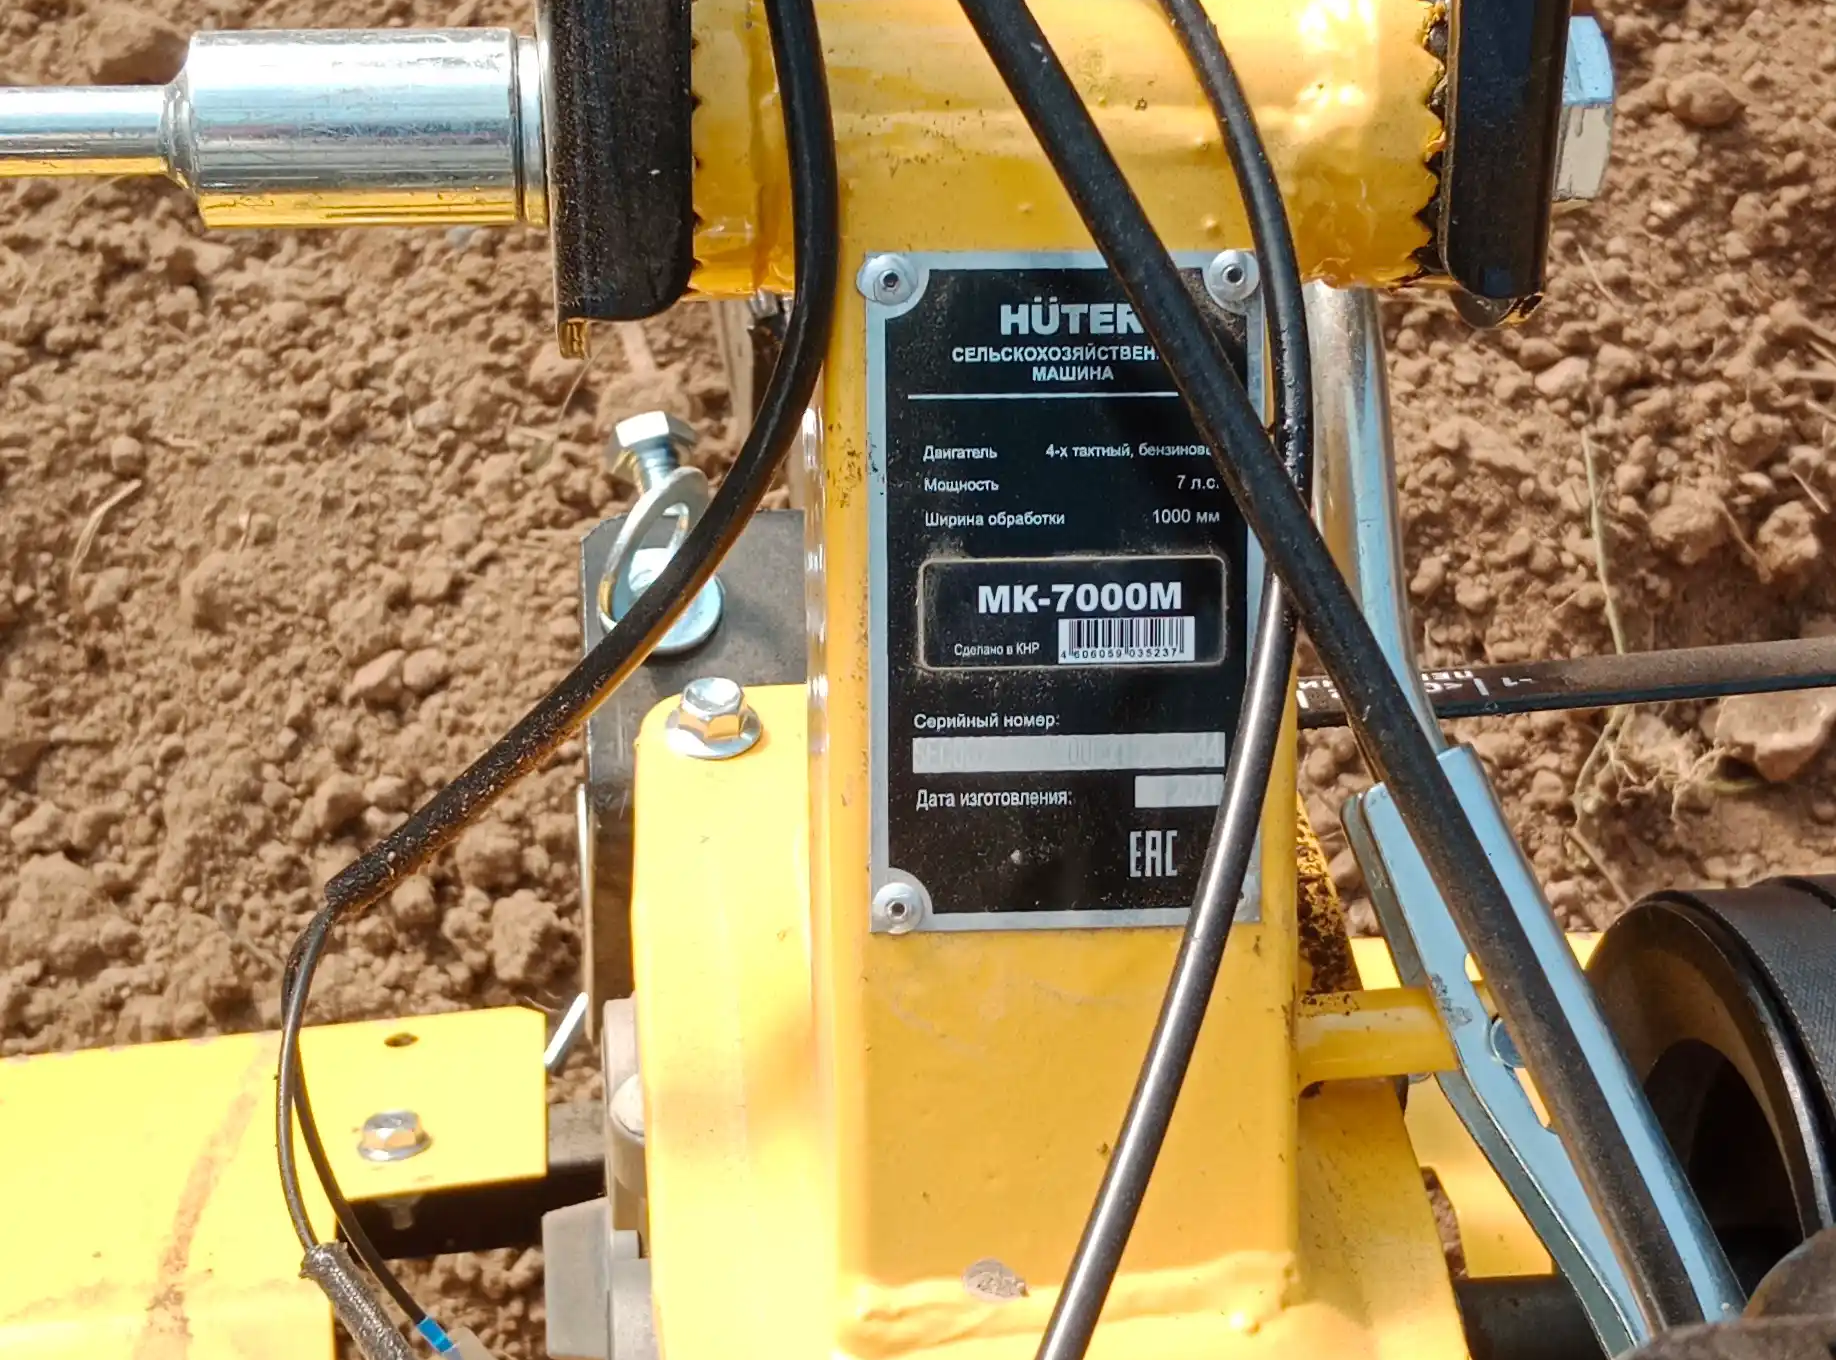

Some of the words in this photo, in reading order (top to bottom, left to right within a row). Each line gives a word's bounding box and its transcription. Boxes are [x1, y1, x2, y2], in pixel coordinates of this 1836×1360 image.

[952, 343, 1159, 363] СЕЛЬСКОХОЗЯЙСТВЕН
[1032, 365, 1114, 382] МАШИНА
[922, 444, 998, 461] Двигатель
[1045, 442, 1068, 458] 4-х
[1072, 442, 1134, 459] тактный,
[924, 476, 1000, 493] Мощность
[1176, 474, 1186, 490] 7
[1190, 476, 1220, 491] л.с.
[925, 510, 984, 529] Ширина
[988, 510, 1066, 528] обработки
[1152, 508, 1191, 525] 1000
[1196, 511, 1220, 524] мм
[978, 581, 1182, 614] МК-7000М
[953, 643, 1003, 658] Сделано
[1006, 644, 1014, 656] в
[1016, 641, 1040, 655] КНР
[913, 712, 999, 731] Серийный
[1003, 713, 1060, 730] номер:
[916, 789, 956, 811] Дата
[960, 790, 1073, 807] изготовления:
[1129, 830, 1178, 877] EAC
